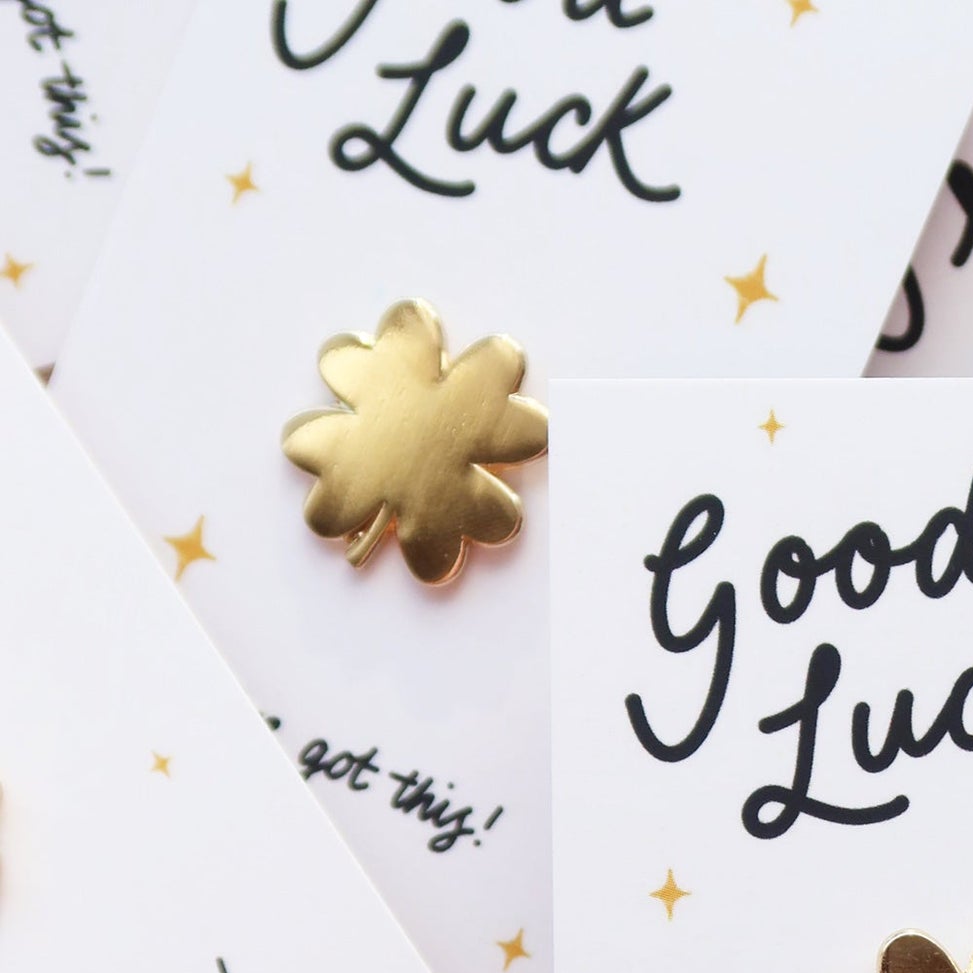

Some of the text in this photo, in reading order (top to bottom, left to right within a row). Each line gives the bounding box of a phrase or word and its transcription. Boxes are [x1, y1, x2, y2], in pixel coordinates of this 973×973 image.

[32, 60, 112, 179] this!
[327, 18, 682, 203] Luck
[298, 737, 504, 854] got this!
